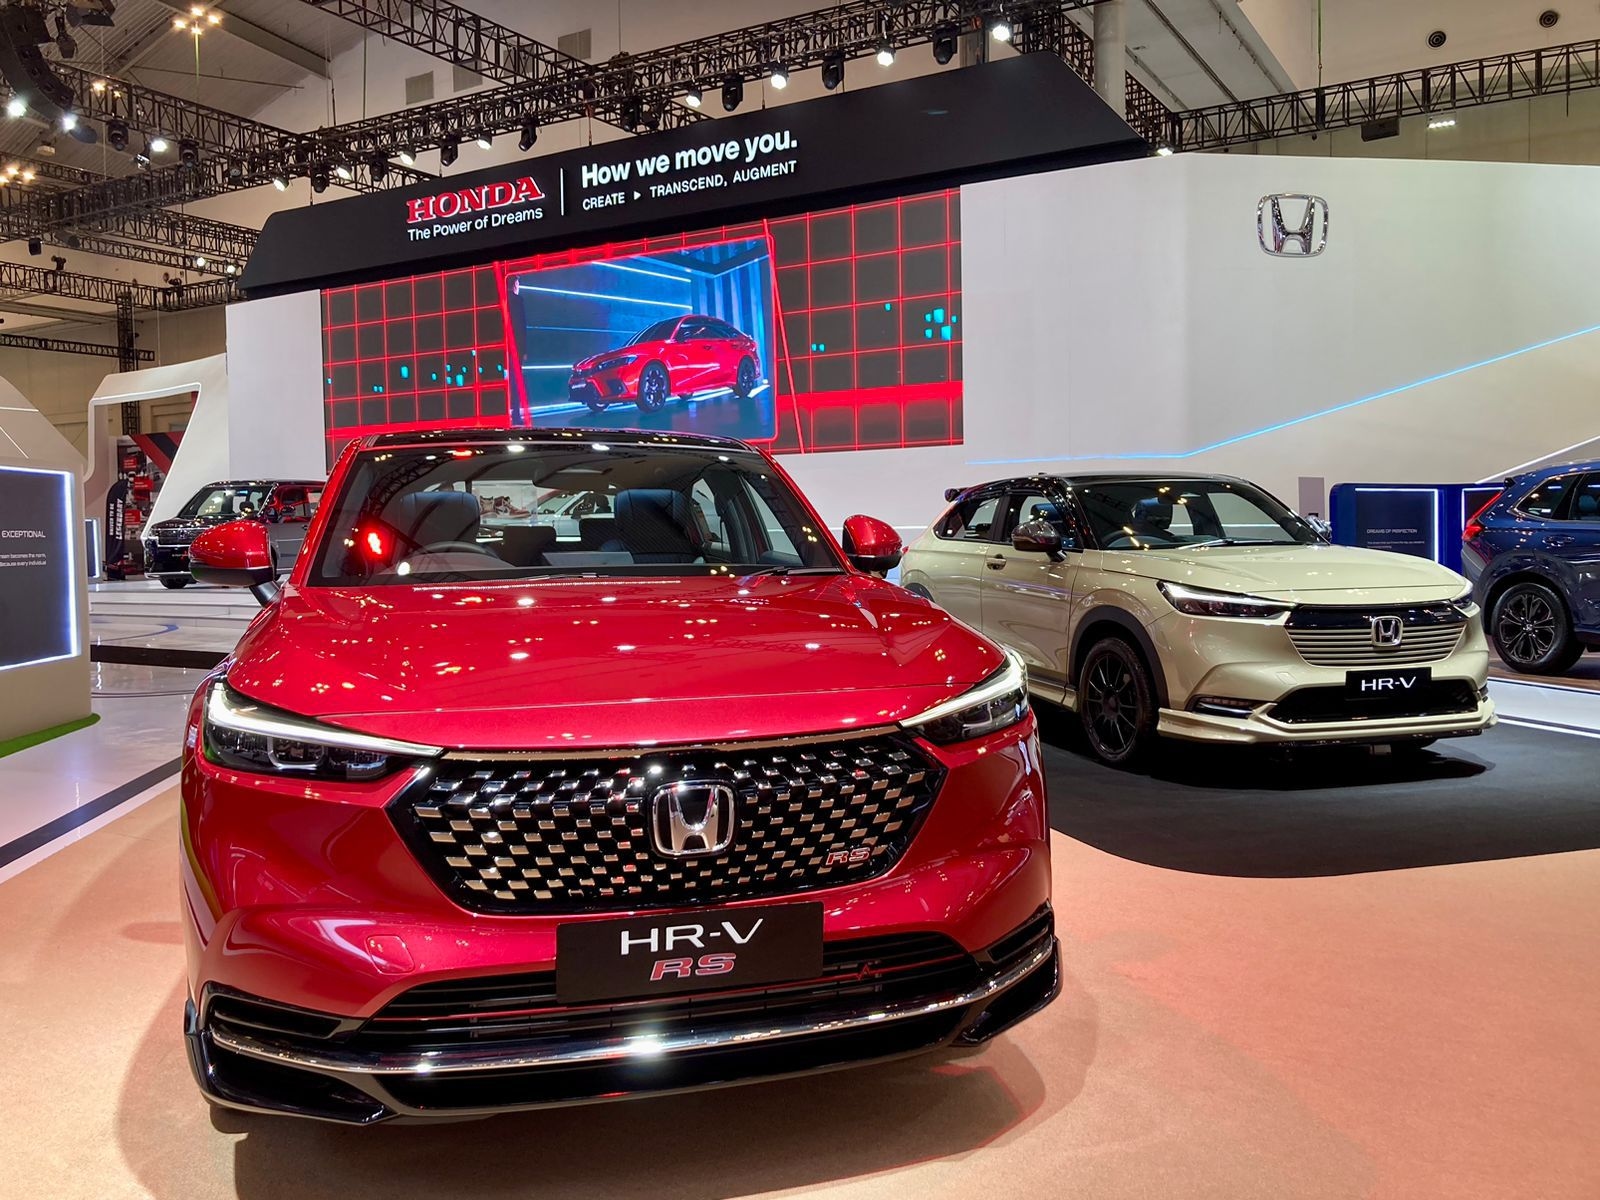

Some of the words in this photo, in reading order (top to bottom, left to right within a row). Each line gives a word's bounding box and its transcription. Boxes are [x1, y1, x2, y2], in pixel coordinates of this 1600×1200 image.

[581, 161, 632, 188] How
[636, 157, 670, 177] we
[675, 142, 740, 170] move
[745, 129, 798, 162] you.
[406, 176, 545, 224] HONDA
[583, 191, 625, 211] CREATE
[650, 172, 727, 199] TRANSCEND,
[733, 160, 797, 183] AUGMENT
[407, 226, 431, 242] The
[433, 220, 473, 237] Power
[475, 215, 488, 229] of
[491, 206, 543, 226] Dreams
[1, 530, 46, 538] EXCEPTIONAL
[1361, 676, 1416, 692] HR-V
[825, 847, 870, 865] RS
[620, 918, 764, 956] HR-V
[650, 952, 736, 982] RS
